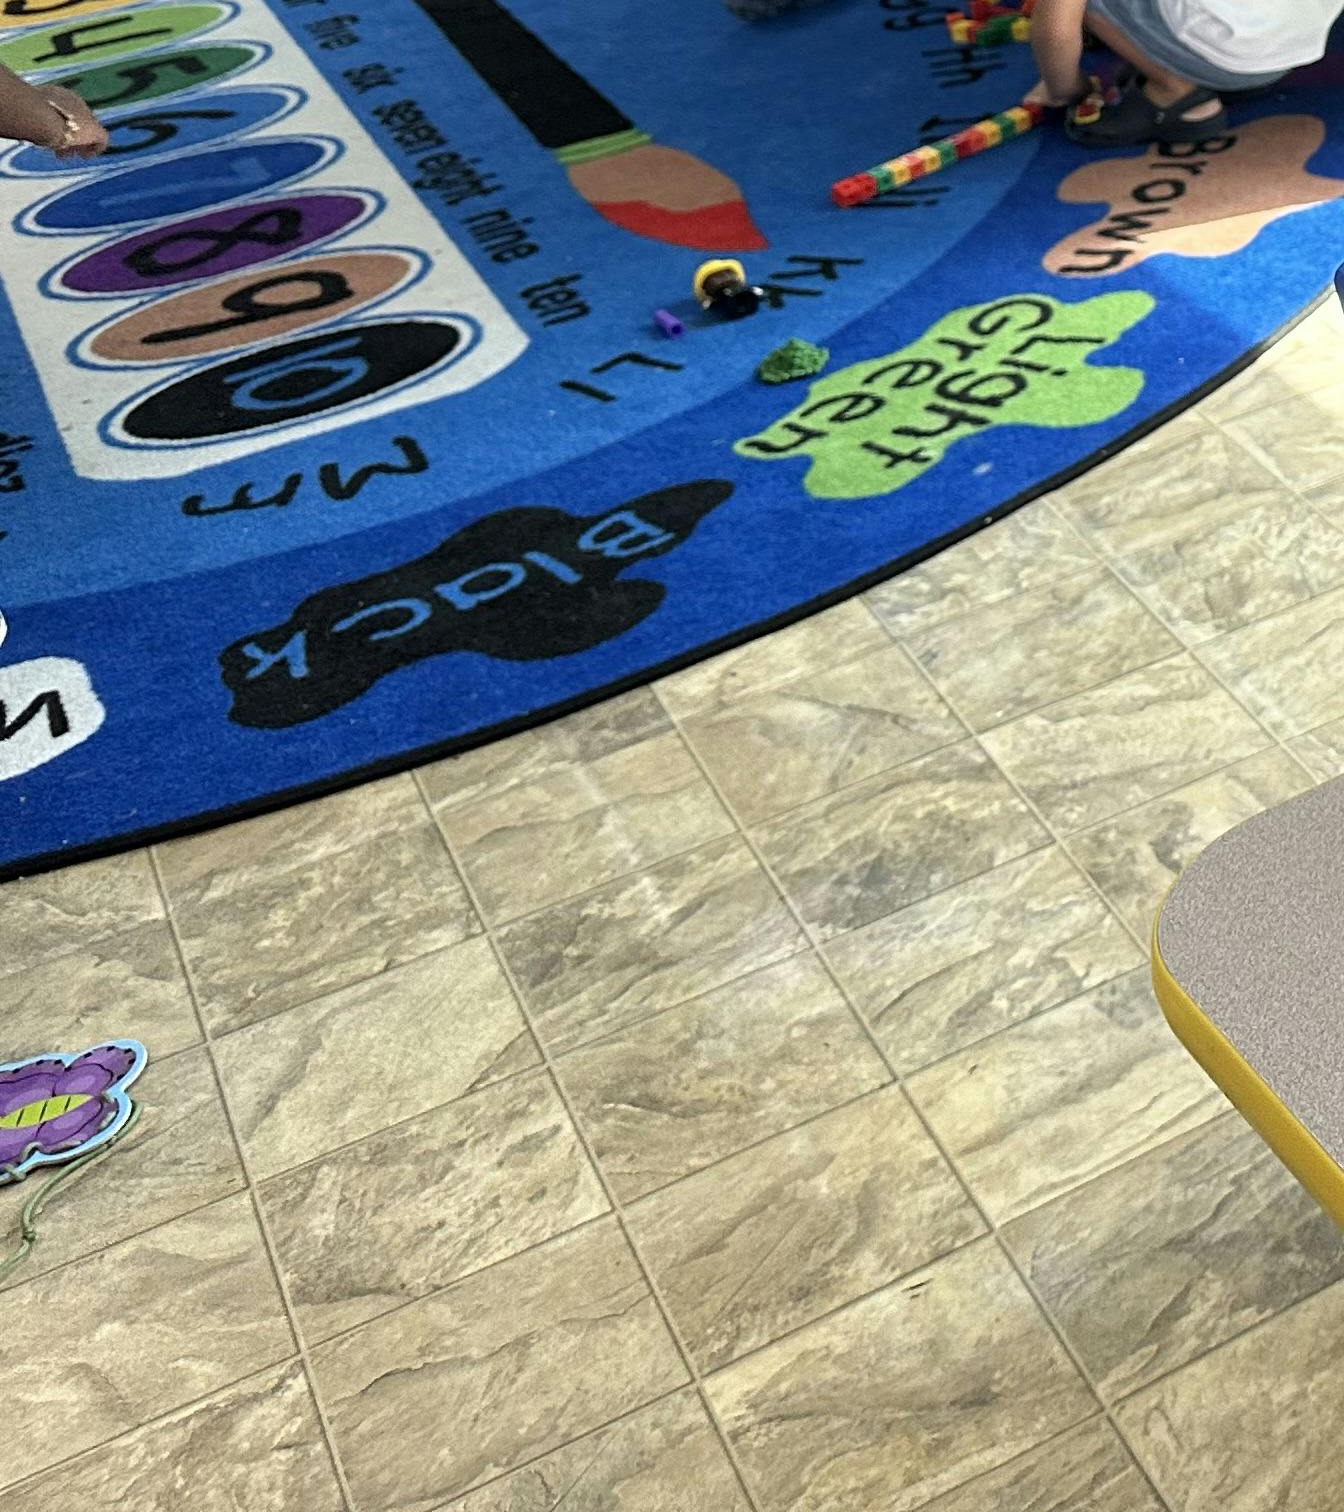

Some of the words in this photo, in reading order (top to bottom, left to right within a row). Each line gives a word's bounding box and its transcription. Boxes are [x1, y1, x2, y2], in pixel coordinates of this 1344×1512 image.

[32, 15, 174, 64] 4
[372, 99, 448, 156] seven
[412, 150, 506, 207] eight
[1058, 135, 1240, 277] Brown
[122, 207, 303, 278] 8
[460, 207, 540, 264] nine
[141, 270, 356, 345] 9
[519, 272, 591, 329] ten
[223, 337, 368, 411] 10
[744, 297, 1054, 454] Green
[862, 333, 1107, 470] Light
[238, 507, 678, 682] Black
